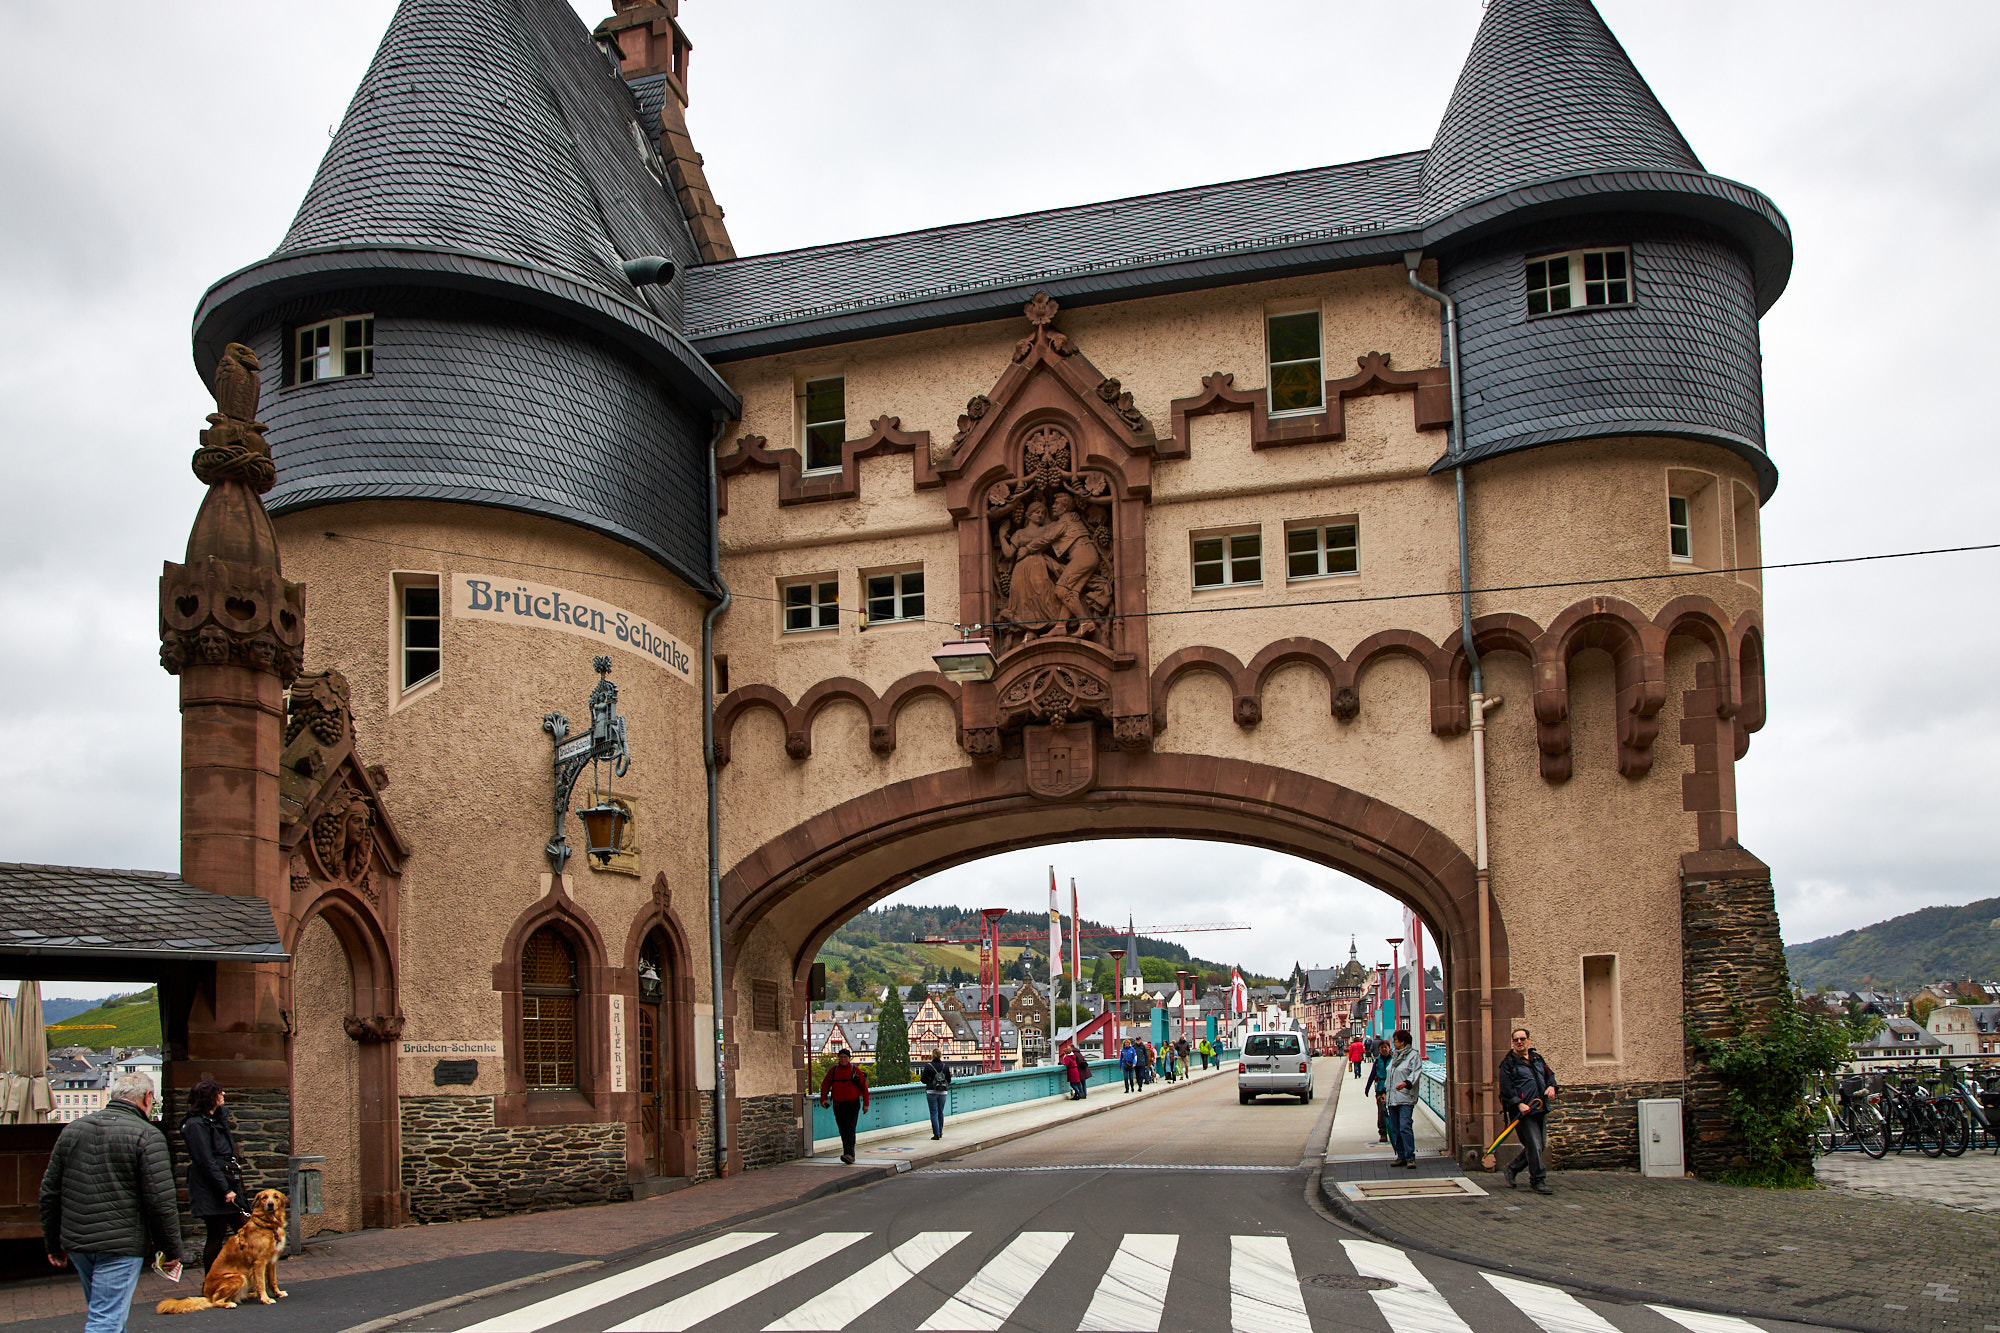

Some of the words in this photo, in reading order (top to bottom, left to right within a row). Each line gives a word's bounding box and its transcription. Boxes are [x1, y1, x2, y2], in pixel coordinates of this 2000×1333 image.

[466, 579, 689, 675] Brücken-Schenke
[403, 1043, 497, 1053] Brücken-Schenke
[613, 999, 622, 1087] GALERIE
